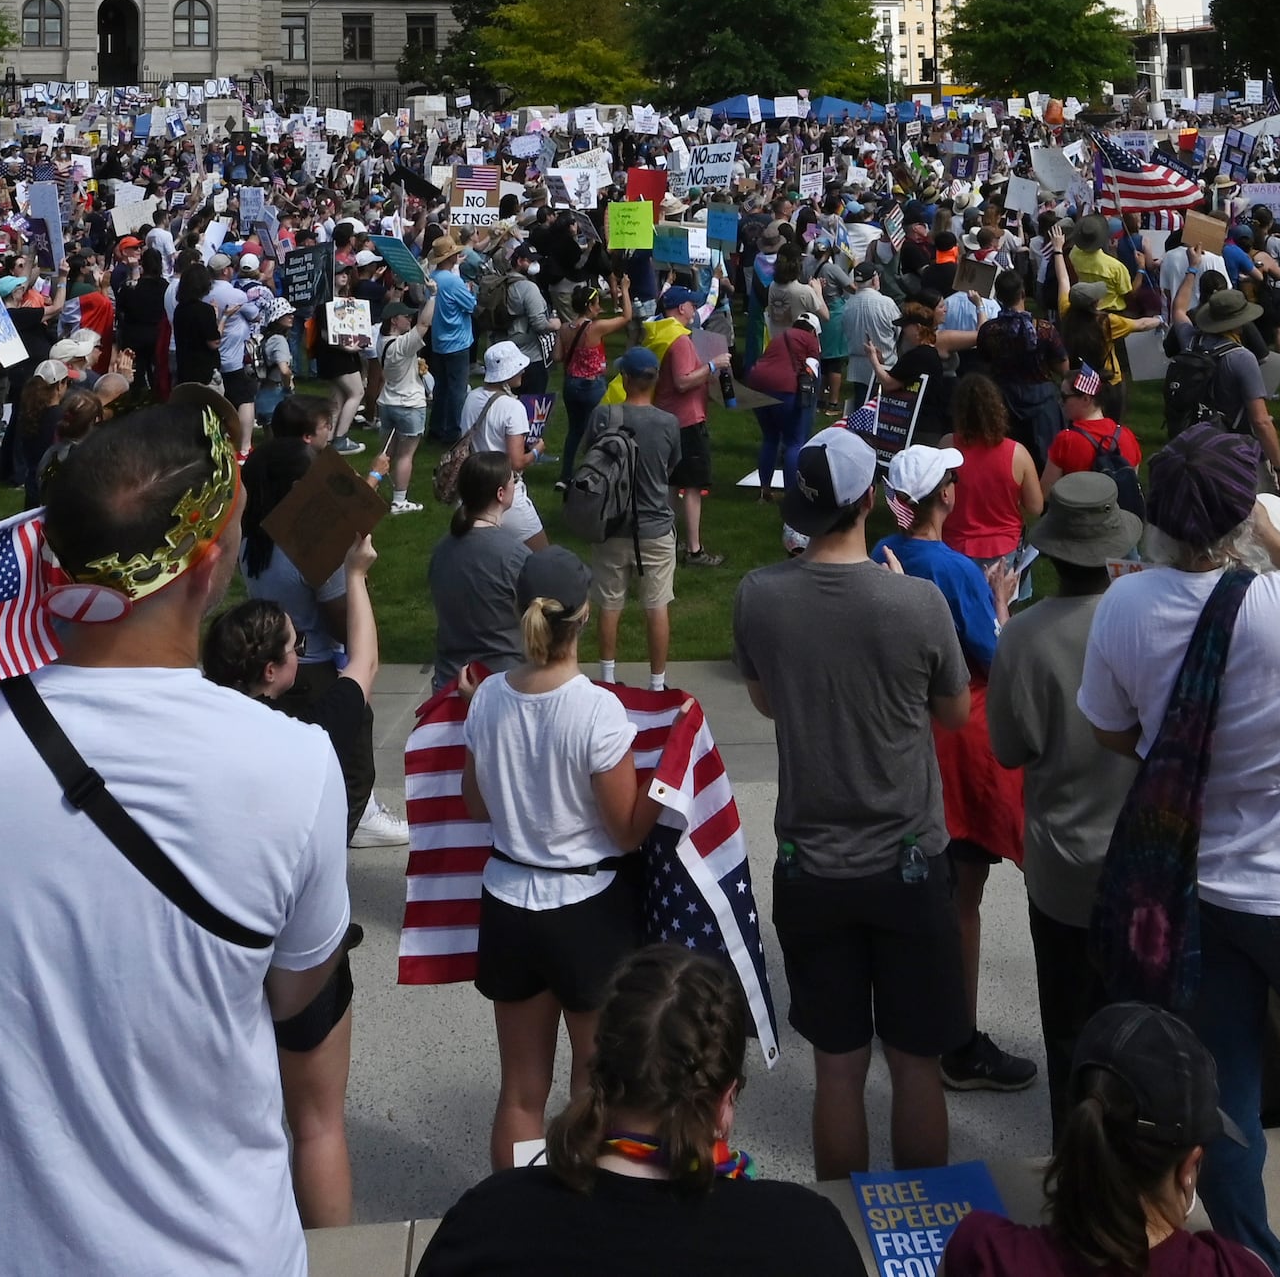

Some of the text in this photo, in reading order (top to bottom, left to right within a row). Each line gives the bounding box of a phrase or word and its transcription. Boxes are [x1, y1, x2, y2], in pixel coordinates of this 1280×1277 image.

[24, 82, 87, 100] TRUMP
[691, 147, 731, 166] NO KINGS
[1156, 153, 1189, 175] NO KINGS
[687, 166, 705, 186] NO
[703, 175, 728, 185] DESPOTS
[465, 196, 486, 208] NO
[451, 213, 499, 225] KINGS
[880, 396, 908, 409] EALTHCARE
[860, 1179, 929, 1206] FREE
[867, 1201, 973, 1232] SPEECH
[874, 1229, 945, 1256] FREE
